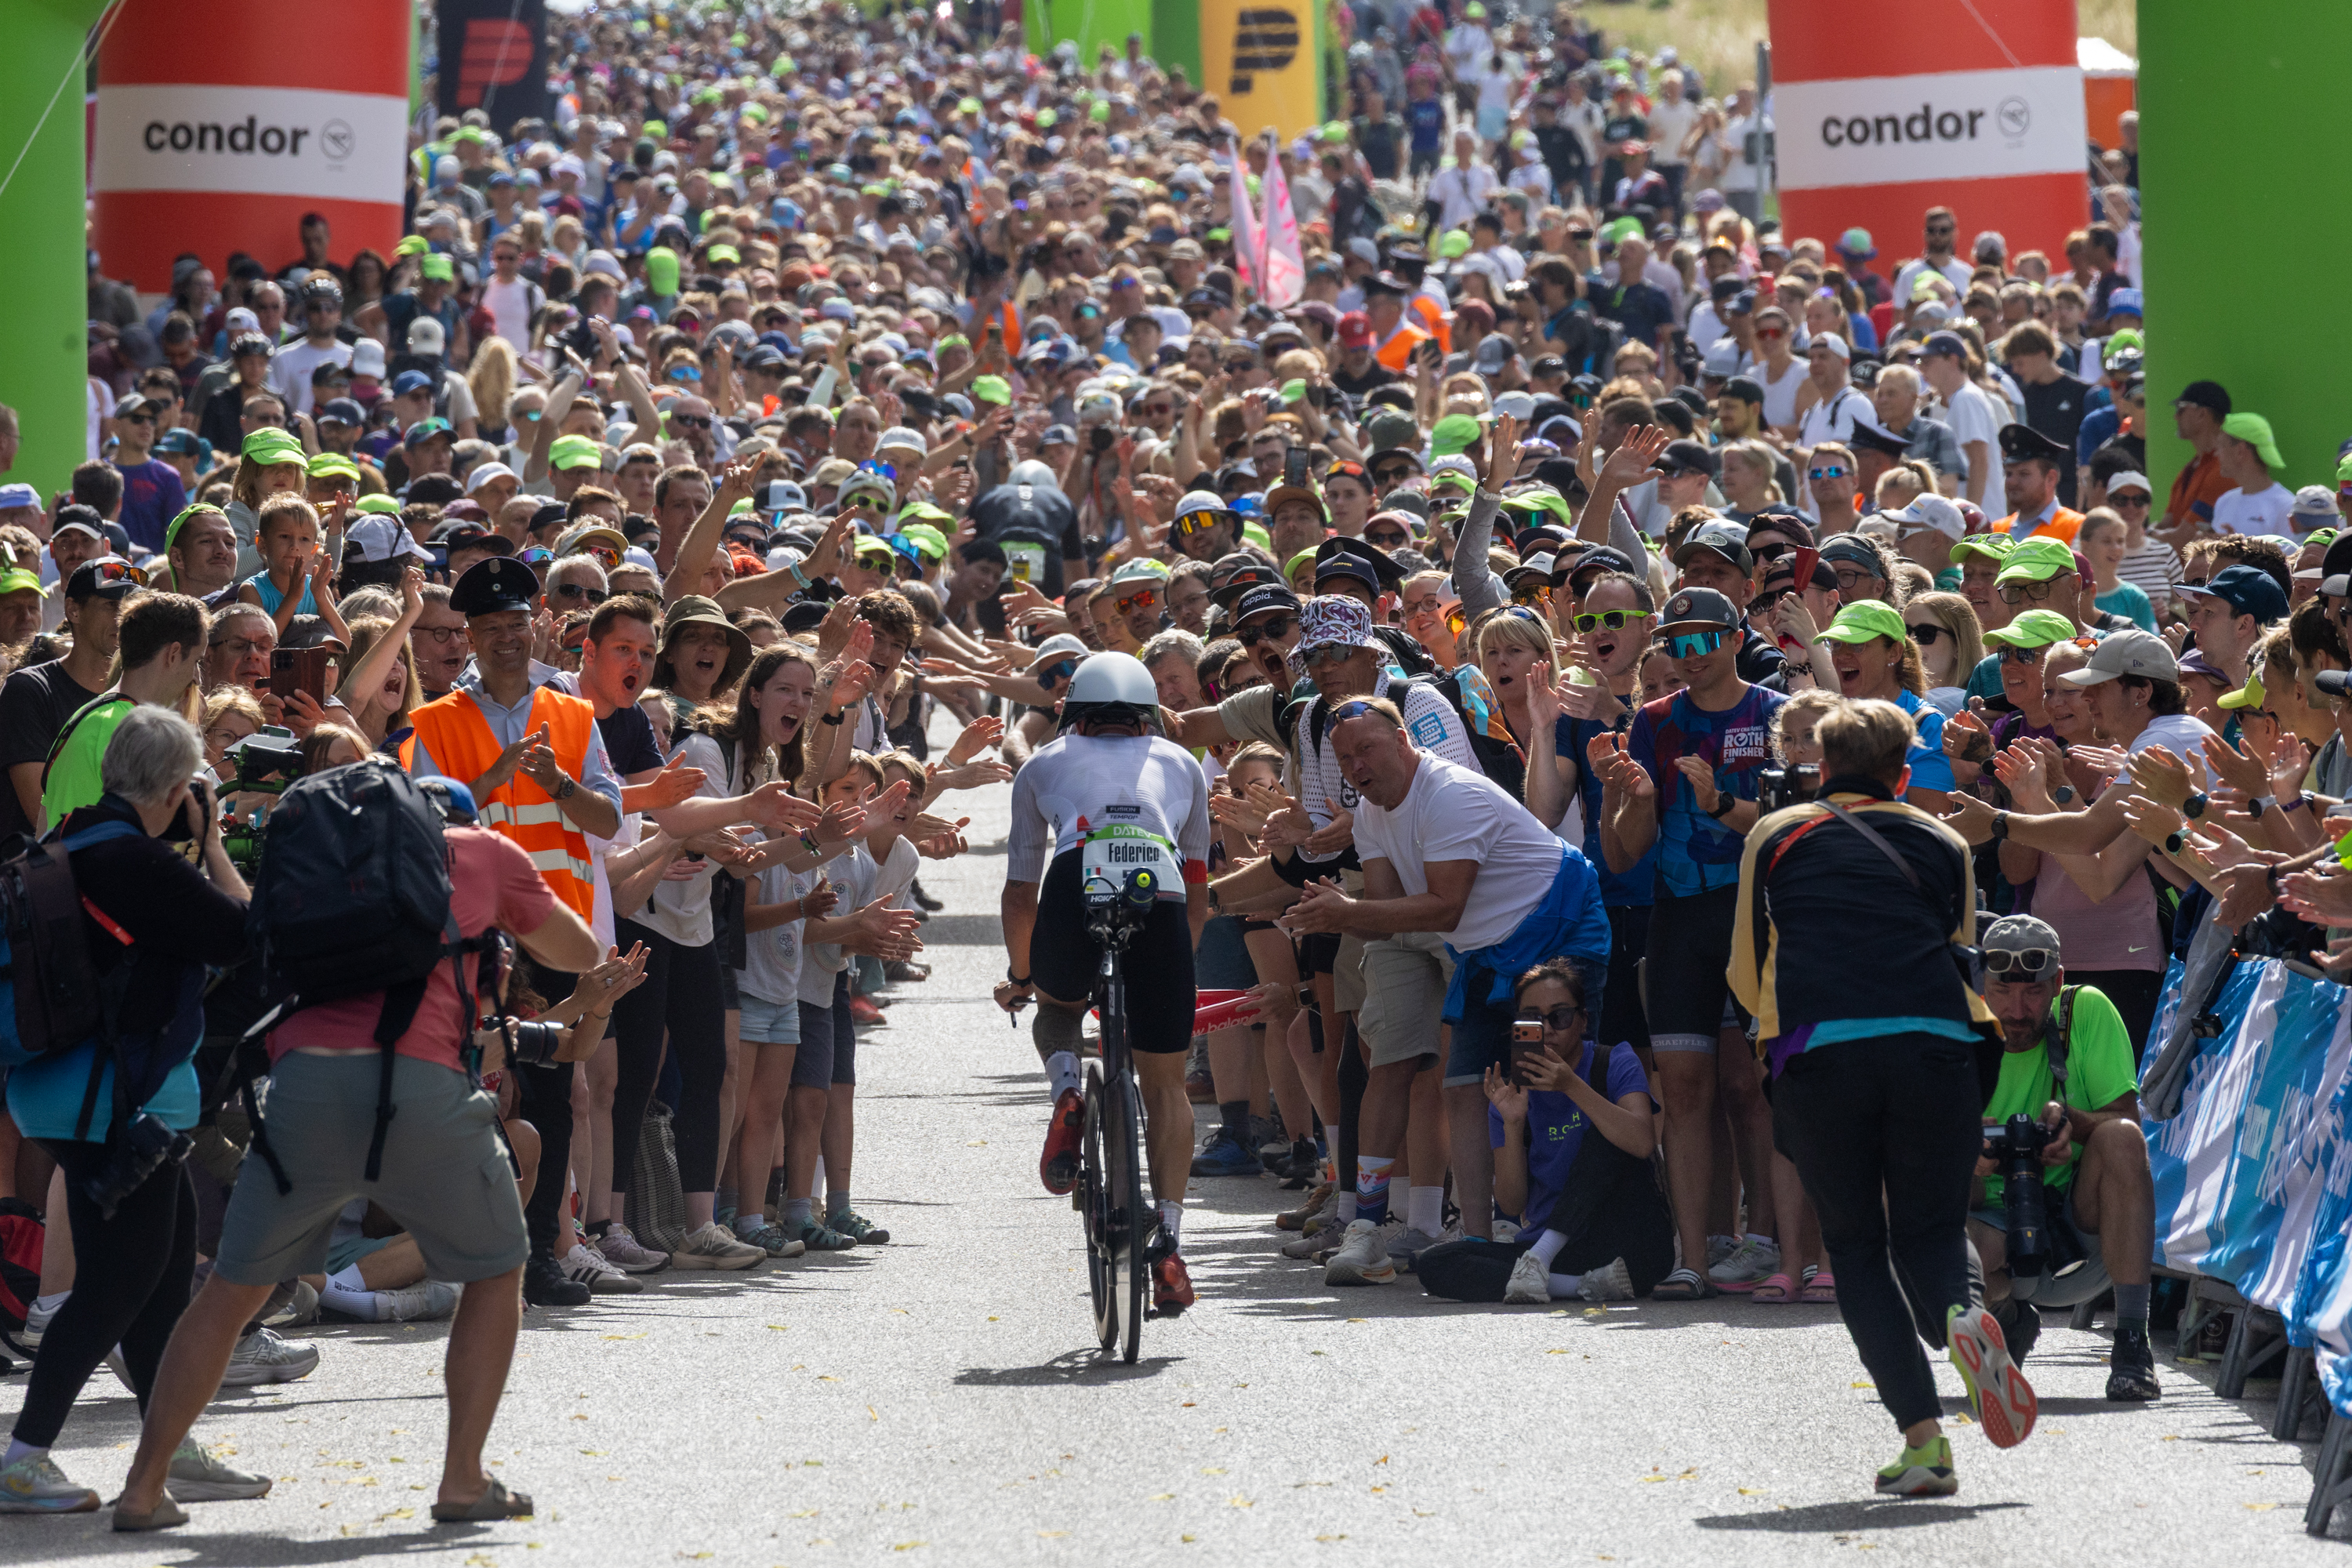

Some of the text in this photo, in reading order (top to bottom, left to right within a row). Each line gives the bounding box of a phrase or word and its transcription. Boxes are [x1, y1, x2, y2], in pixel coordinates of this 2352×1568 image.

[1821, 103, 1984, 147] condor
[144, 114, 310, 156] condor
[1242, 592, 1273, 609] rappid.
[1724, 731, 1764, 748] ROTH
[1723, 746, 1765, 758] FINISHER
[1113, 826, 1152, 838] DATEV
[1109, 843, 1160, 863] Federico
[1207, 1016, 1250, 1033] balan
